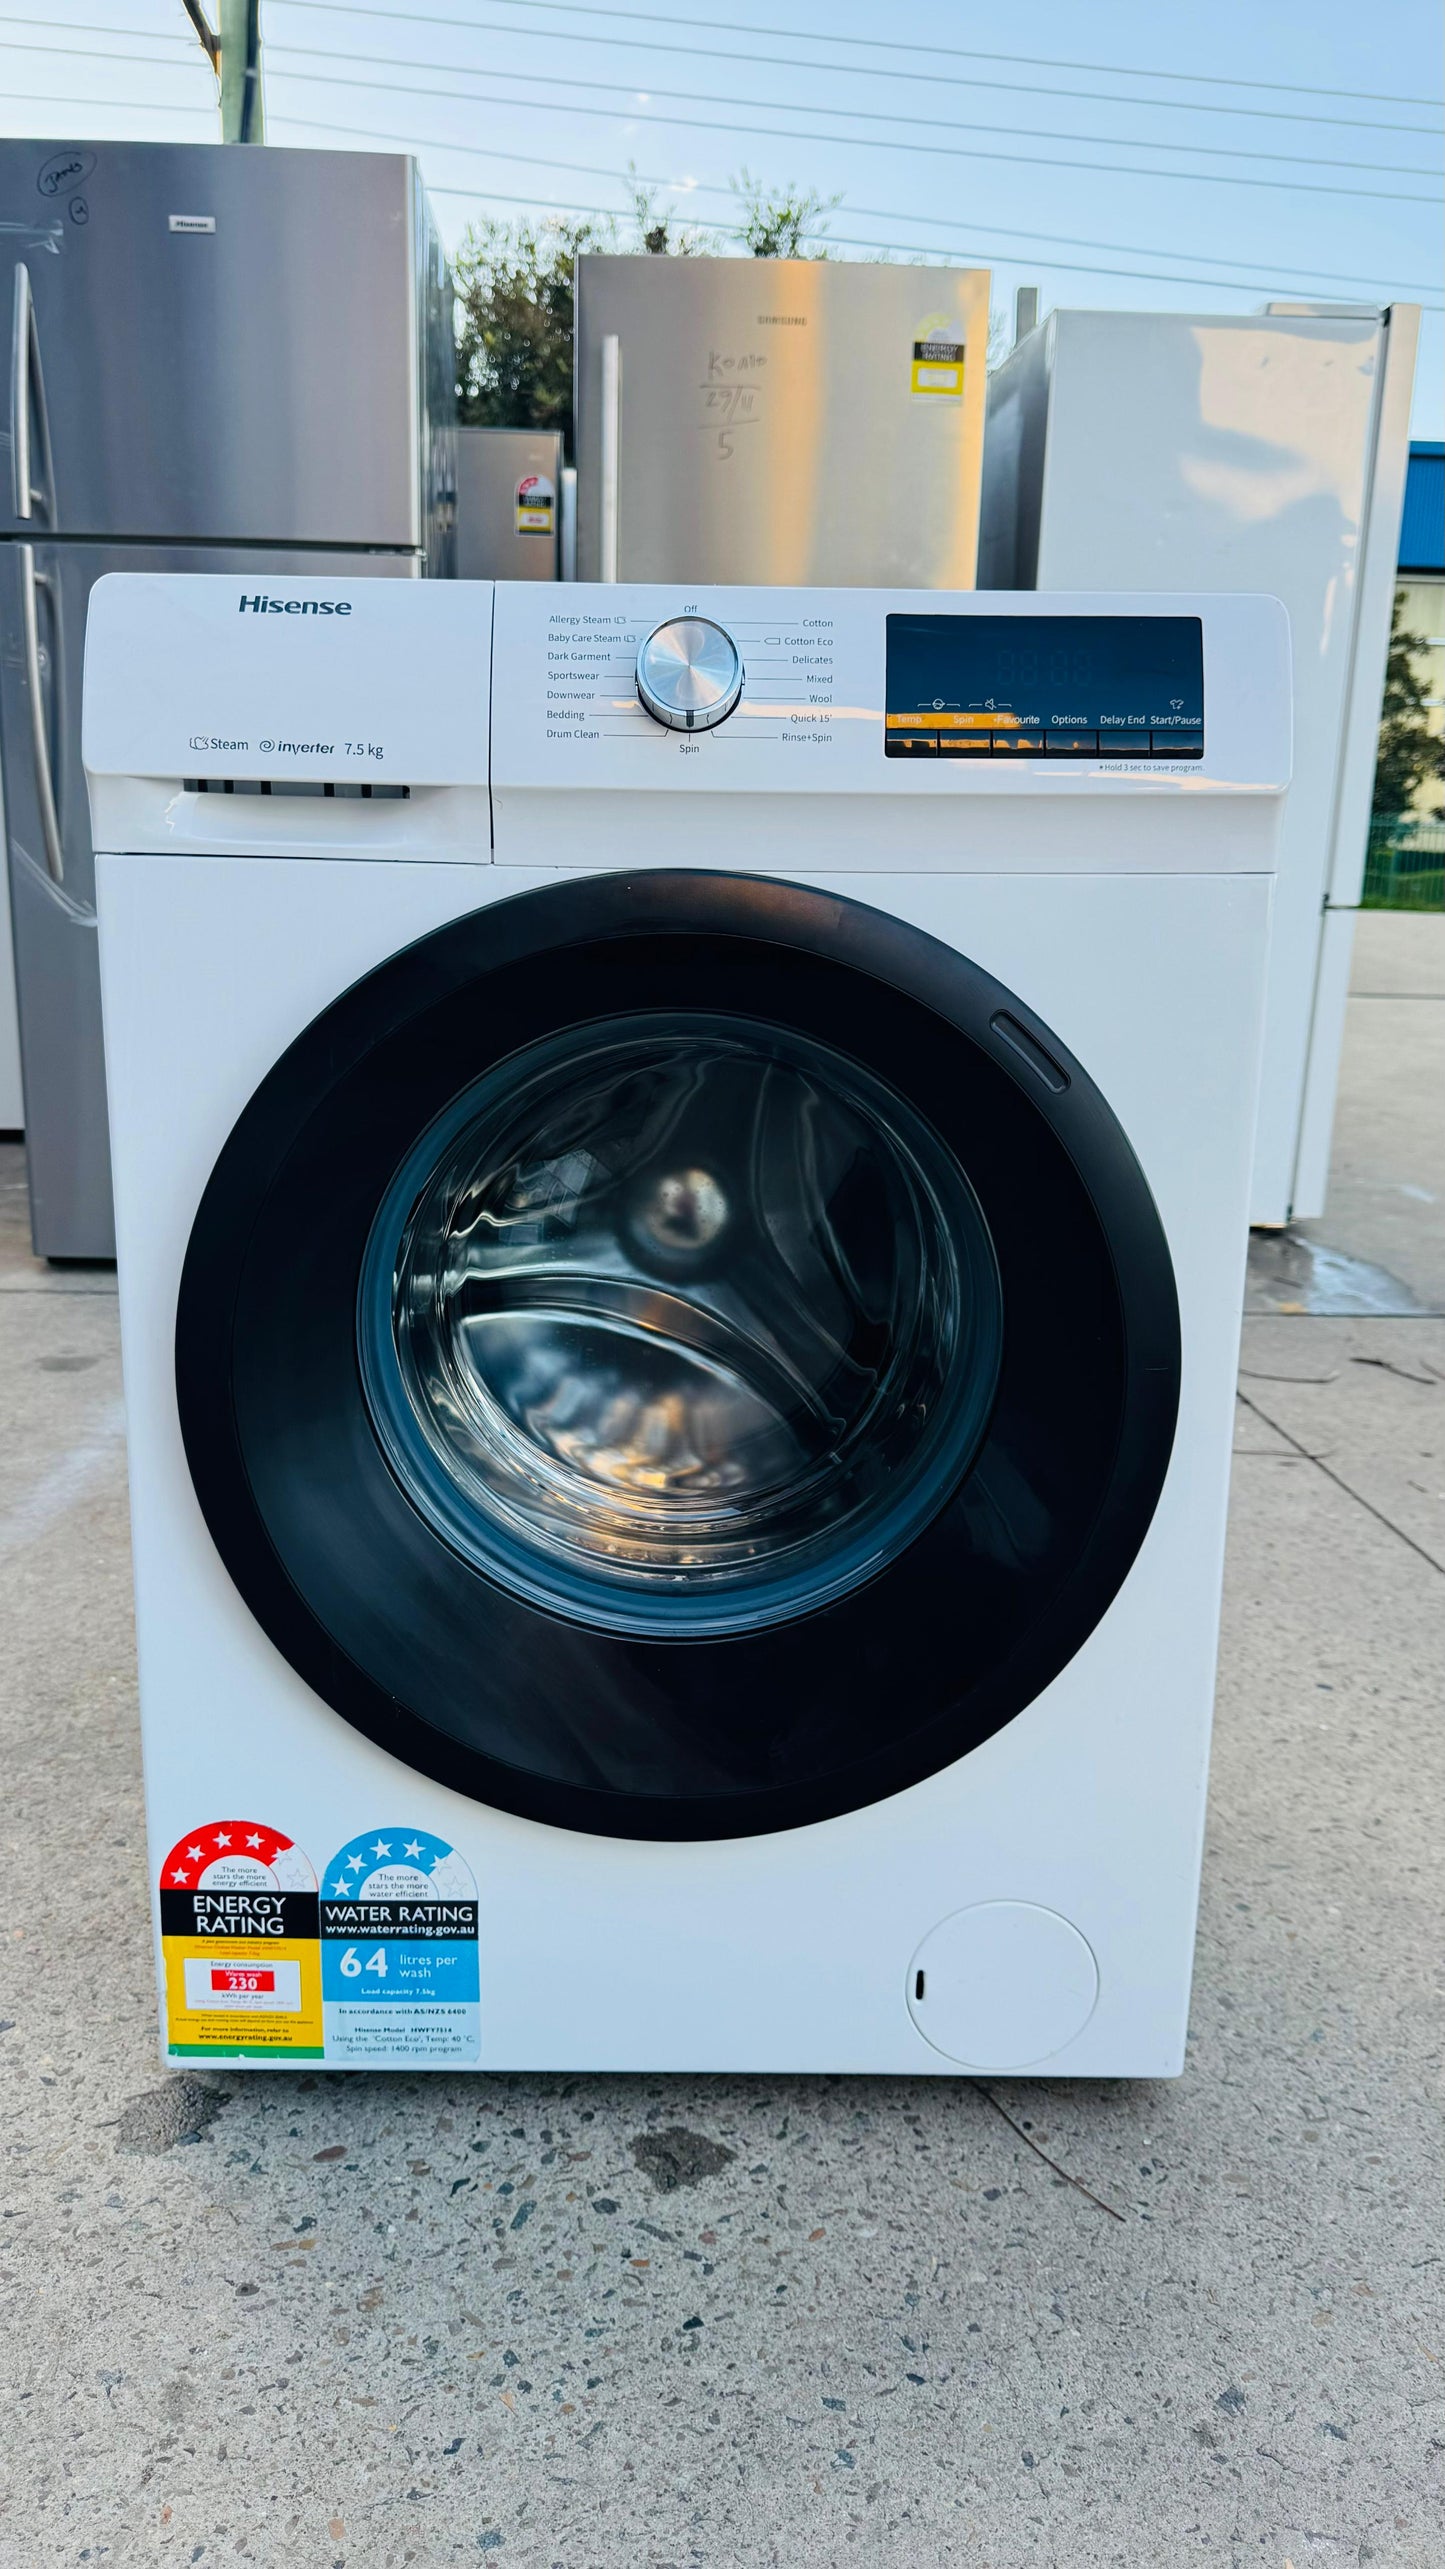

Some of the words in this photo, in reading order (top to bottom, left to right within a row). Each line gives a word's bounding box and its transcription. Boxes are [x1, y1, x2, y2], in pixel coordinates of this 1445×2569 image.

[238, 595, 352, 616] Hisense
[683, 605, 697, 613] Off
[549, 615, 581, 625] Allergy
[582, 616, 611, 624] Steam
[802, 619, 833, 627] Cotton
[548, 633, 571, 643] Baby
[571, 634, 592, 642] Care
[593, 634, 621, 643] Steam
[784, 637, 815, 646] Cotton
[817, 637, 834, 646] Eco
[547, 652, 569, 661] Dark
[570, 652, 611, 661] Garment
[792, 655, 834, 664] Delicates
[547, 671, 600, 682] Sportswear
[806, 675, 833, 684] Mixed
[547, 691, 595, 699] Downwear
[809, 694, 833, 703] Wool
[546, 710, 585, 721] Bedding
[790, 714, 817, 724] Quick
[953, 714, 975, 726] Spin
[1051, 715, 1088, 725] Options
[1100, 715, 1126, 726] Delay
[1127, 716, 1146, 725] End
[1150, 716, 1202, 726] Start/Pause
[546, 729, 572, 738] Drum
[574, 729, 600, 739] Clean
[782, 733, 832, 744] Rinse+Spin
[210, 738, 249, 751] Steam
[277, 740, 335, 755] inverter
[344, 743, 365, 756] 7.5
[367, 743, 384, 760] kg
[679, 744, 700, 755] Spin
[378, 1873, 395, 1881] The
[212, 1880, 237, 1888] energy
[391, 1881, 404, 1889] the
[193, 1895, 286, 1915] ENERGY
[325, 1906, 392, 1922] WATER
[399, 1906, 473, 1922] RATING
[196, 1915, 284, 1935] RATING
[325, 1923, 475, 1937] www.waterrating.gov.au
[339, 1947, 389, 1978] 64
[399, 1954, 432, 1966] litres
[436, 1955, 458, 1968] per
[399, 1967, 432, 1979] wash
[228, 1977, 258, 1991] 230
[382, 1988, 413, 1997] capacity
[416, 1988, 436, 1997] 7.5kg
